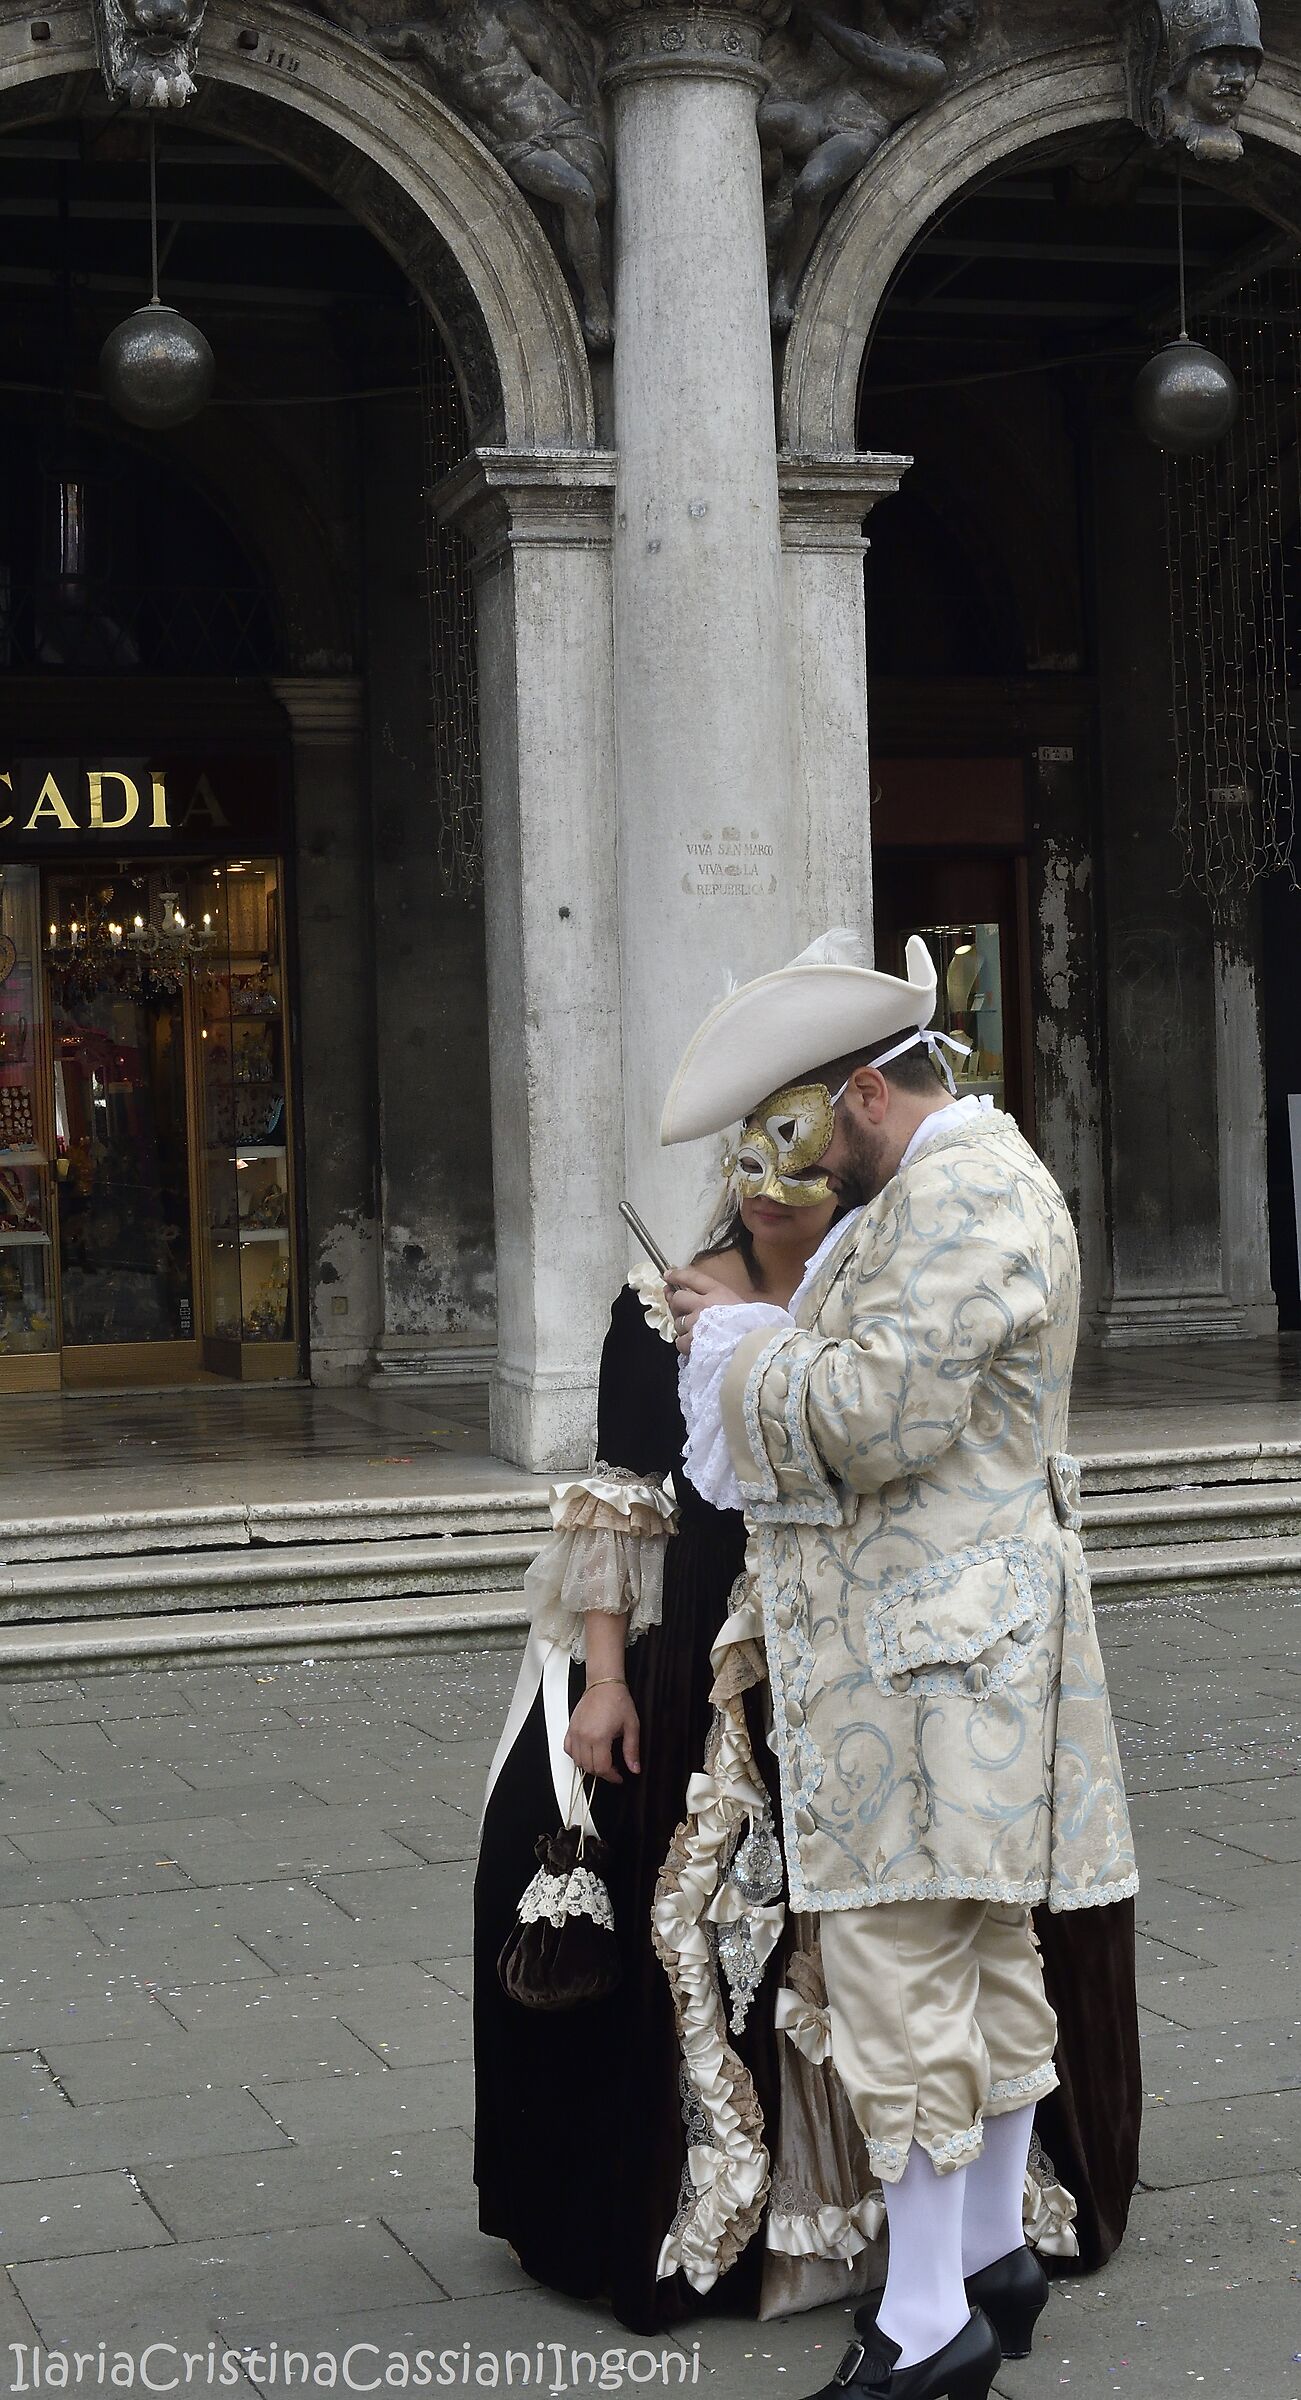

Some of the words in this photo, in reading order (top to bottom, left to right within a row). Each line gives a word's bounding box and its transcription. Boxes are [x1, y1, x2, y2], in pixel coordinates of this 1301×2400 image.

[0, 770, 231, 830] ADIA
[686, 844, 713, 856] VIVA
[718, 844, 742, 856] SAN
[744, 844, 774, 857] MARCO
[698, 863, 723, 876] VIVA
[743, 863, 759, 876] LA
